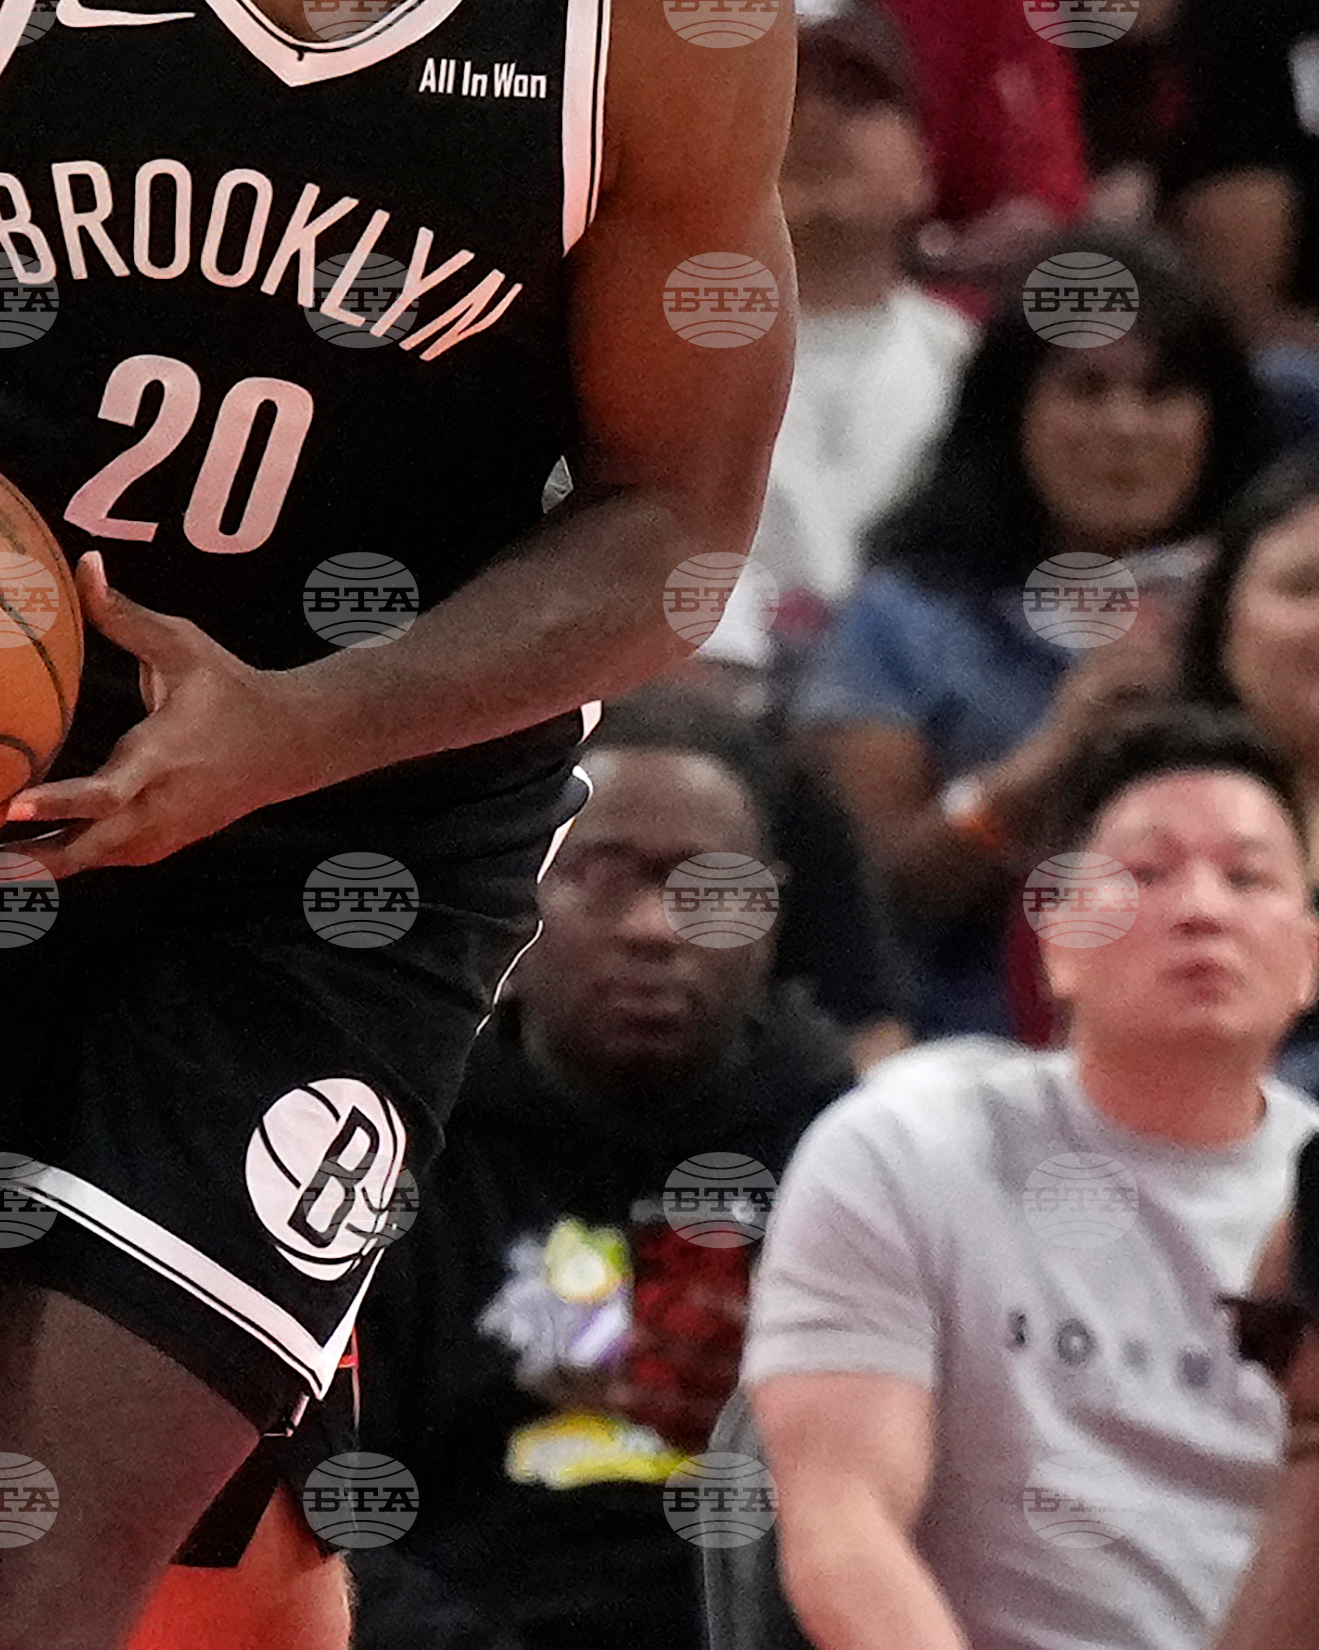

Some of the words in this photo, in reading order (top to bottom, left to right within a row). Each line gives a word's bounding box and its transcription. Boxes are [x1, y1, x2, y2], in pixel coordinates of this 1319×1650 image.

[419, 57, 456, 94] All
[462, 60, 488, 97] In
[494, 61, 547, 99] Won
[63, 354, 314, 555] 20
